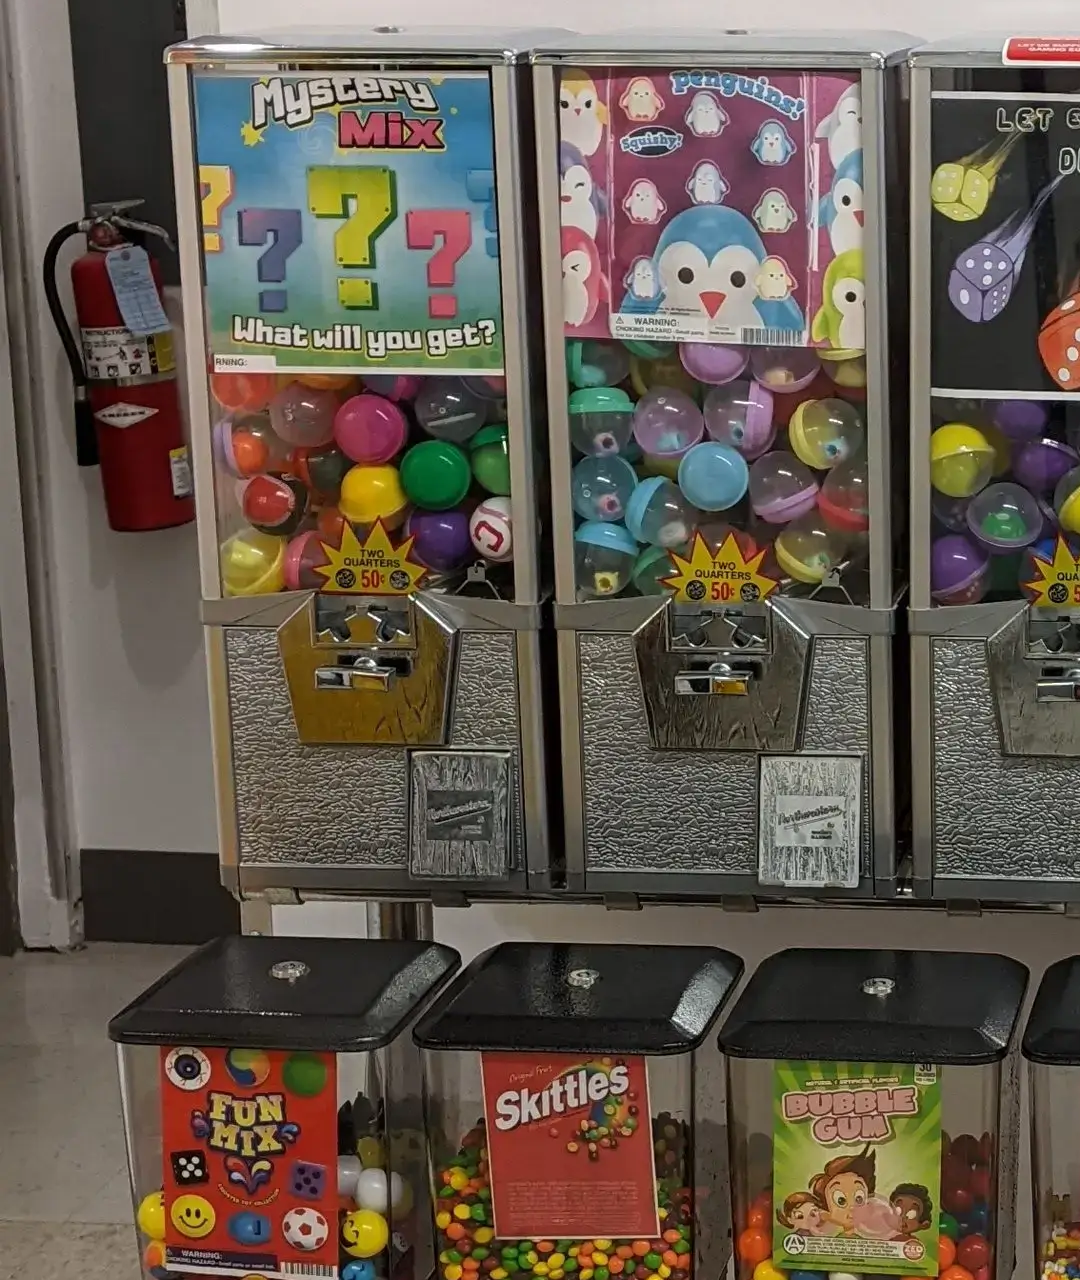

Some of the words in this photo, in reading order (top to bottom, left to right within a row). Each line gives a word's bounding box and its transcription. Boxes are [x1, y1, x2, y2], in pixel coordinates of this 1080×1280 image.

[252, 77, 439, 129] Mystery
[670, 70, 806, 120] penguins!
[339, 111, 445, 148] Mix
[996, 107, 1054, 132] LET
[620, 131, 684, 151] Squishy!
[233, 315, 308, 347] What
[312, 324, 362, 349] will
[366, 328, 422, 358] you
[426, 319, 497, 356] get?
[634, 317, 680, 327] WARNING:
[344, 557, 400, 568] QUARTERS
[360, 549, 385, 558] TWO
[711, 561, 736, 570] TWO
[695, 569, 751, 580] QUARTERS
[209, 1093, 285, 1126] FUN
[495, 1066, 629, 1130] Skittles
[784, 1088, 917, 1117] BUBBLE
[210, 1122, 284, 1157] MIX
[813, 1112, 889, 1142] GUM
[182, 1250, 222, 1260] WARNING:
